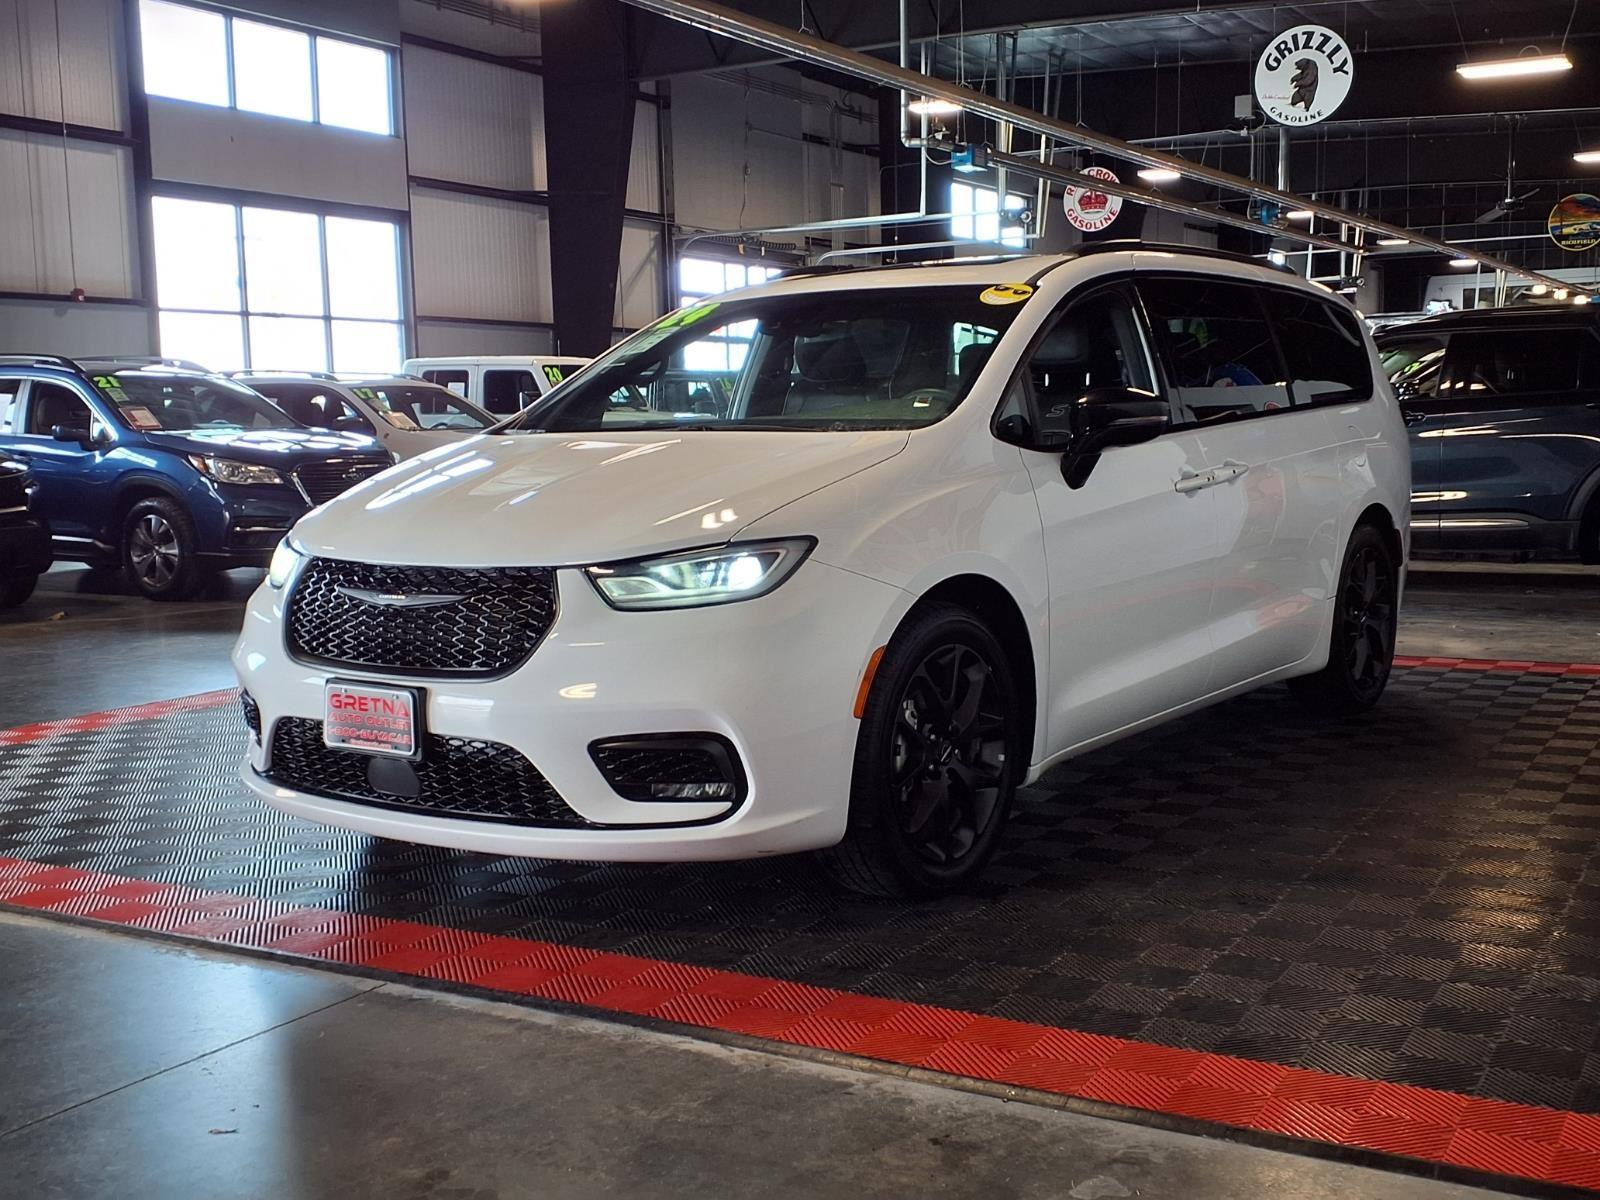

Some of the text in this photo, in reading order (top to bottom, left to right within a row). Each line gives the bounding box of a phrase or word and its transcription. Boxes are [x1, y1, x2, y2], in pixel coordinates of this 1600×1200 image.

[1265, 31, 1349, 75] GRIZZLY
[1270, 106, 1324, 123] GASOLINE
[1067, 207, 1118, 230] GASOLINE
[93, 376, 121, 388] 21
[331, 693, 409, 718] GRETNA
[328, 711, 409, 732] AUTO OUTLET
